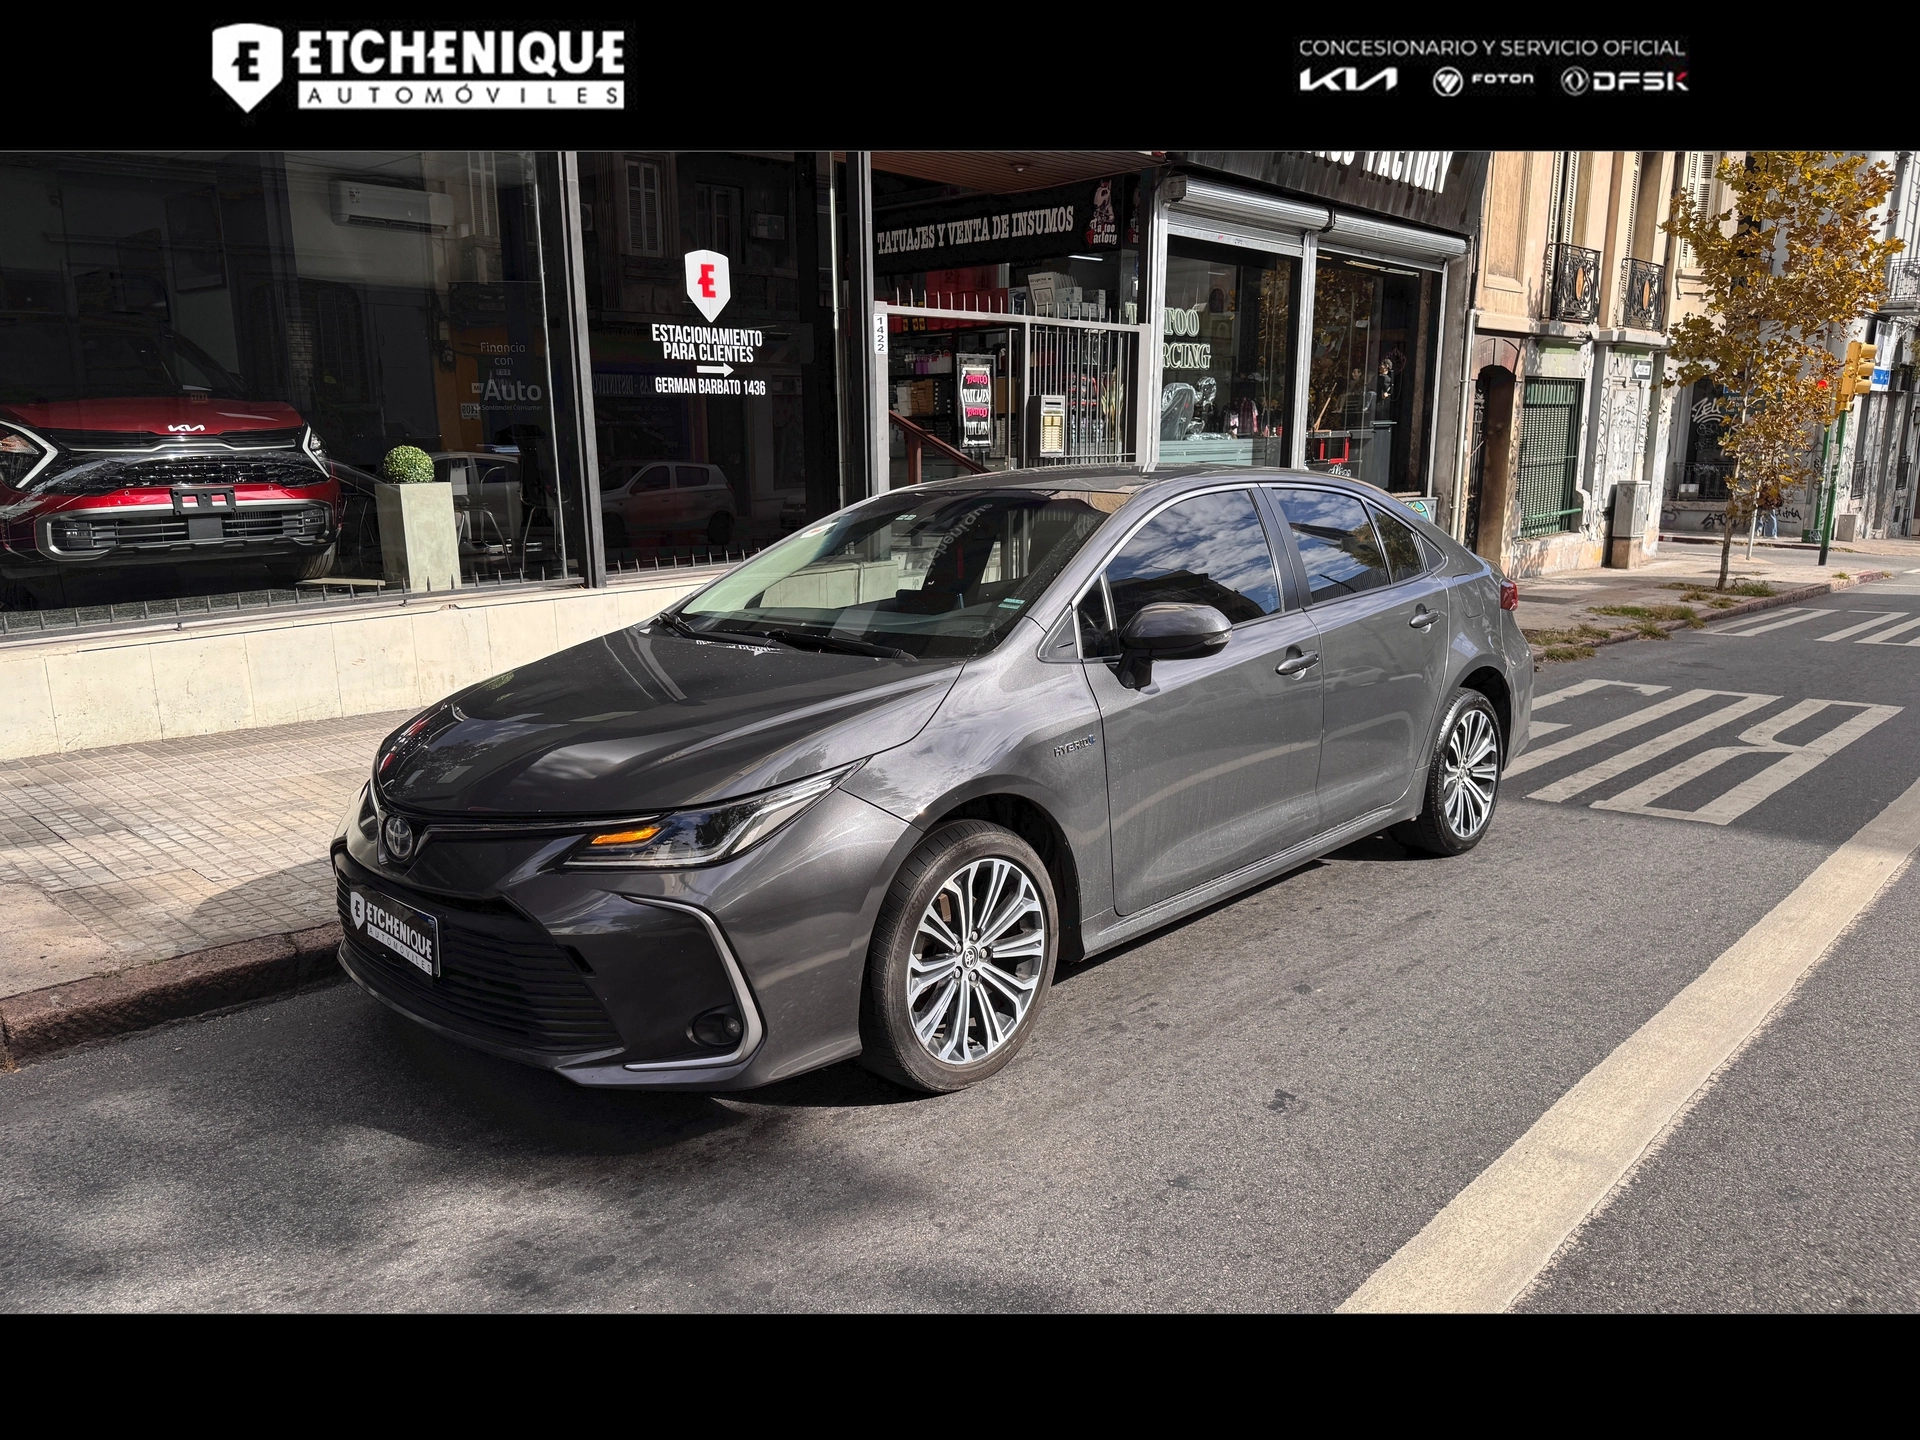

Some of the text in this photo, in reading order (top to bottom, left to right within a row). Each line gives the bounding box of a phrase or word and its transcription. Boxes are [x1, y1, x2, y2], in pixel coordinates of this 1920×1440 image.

[877, 205, 1074, 254] TATUAJES Y VENTA DE INSUMOS
[651, 323, 763, 347] ESTACIONAMIENTO
[876, 316, 885, 352] 1422
[480, 342, 526, 353] Financia
[663, 342, 754, 363] PARA CLIENTES
[494, 357, 514, 366] con
[483, 379, 542, 401] Auto
[655, 377, 766, 396] GERMAN BARBATO 1436
[168, 424, 206, 432] KIA
[366, 902, 432, 961] ETCHENIQUE
